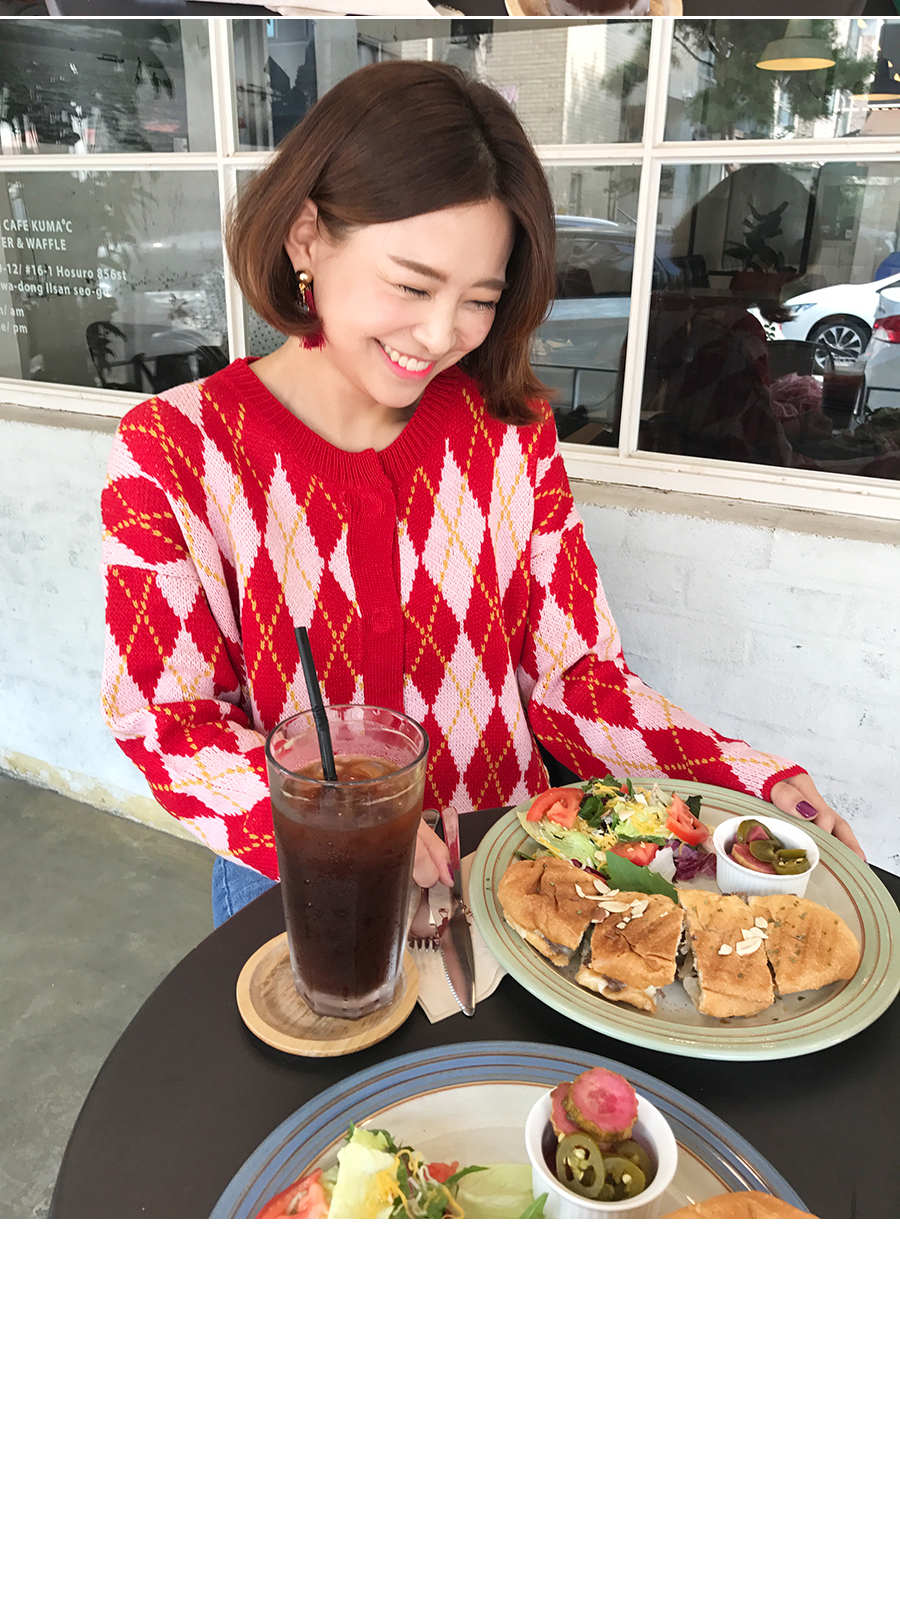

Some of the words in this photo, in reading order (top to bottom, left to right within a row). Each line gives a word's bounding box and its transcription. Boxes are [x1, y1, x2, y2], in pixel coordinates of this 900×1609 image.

[3, 218, 29, 232] CAFE
[16, 236, 24, 249] &
[25, 237, 67, 251] WAFFLE
[25, 264, 53, 277] #16-1
[56, 265, 94, 279] Hosuro
[97, 266, 128, 281] 856st
[73, 286, 110, 300] seo-gu
[10, 307, 25, 318] am
[13, 324, 28, 335] pm
